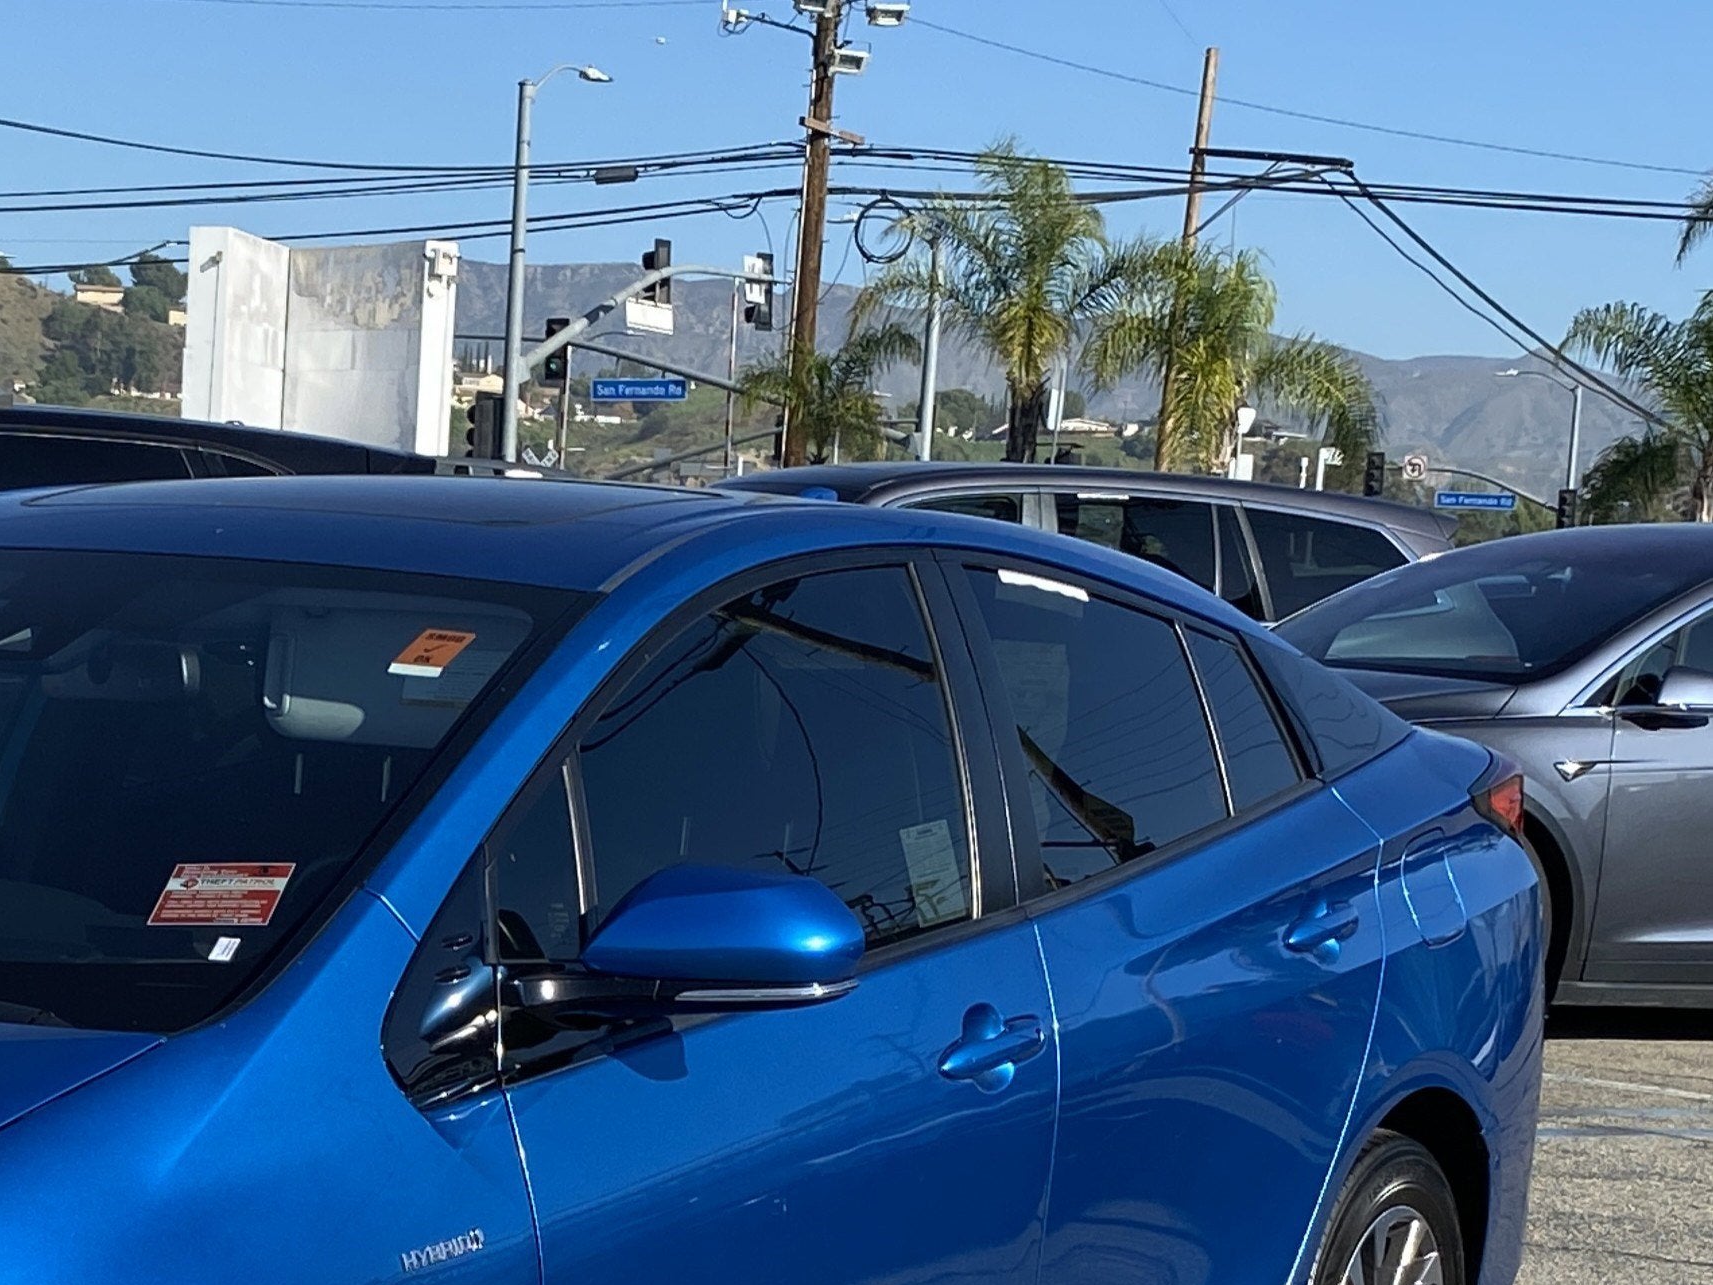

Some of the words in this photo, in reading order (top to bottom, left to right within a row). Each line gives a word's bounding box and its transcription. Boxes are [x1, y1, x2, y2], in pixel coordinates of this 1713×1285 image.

[596, 384, 616, 396] San
[618, 384, 666, 396] Fernando
[668, 383, 682, 396] Rd
